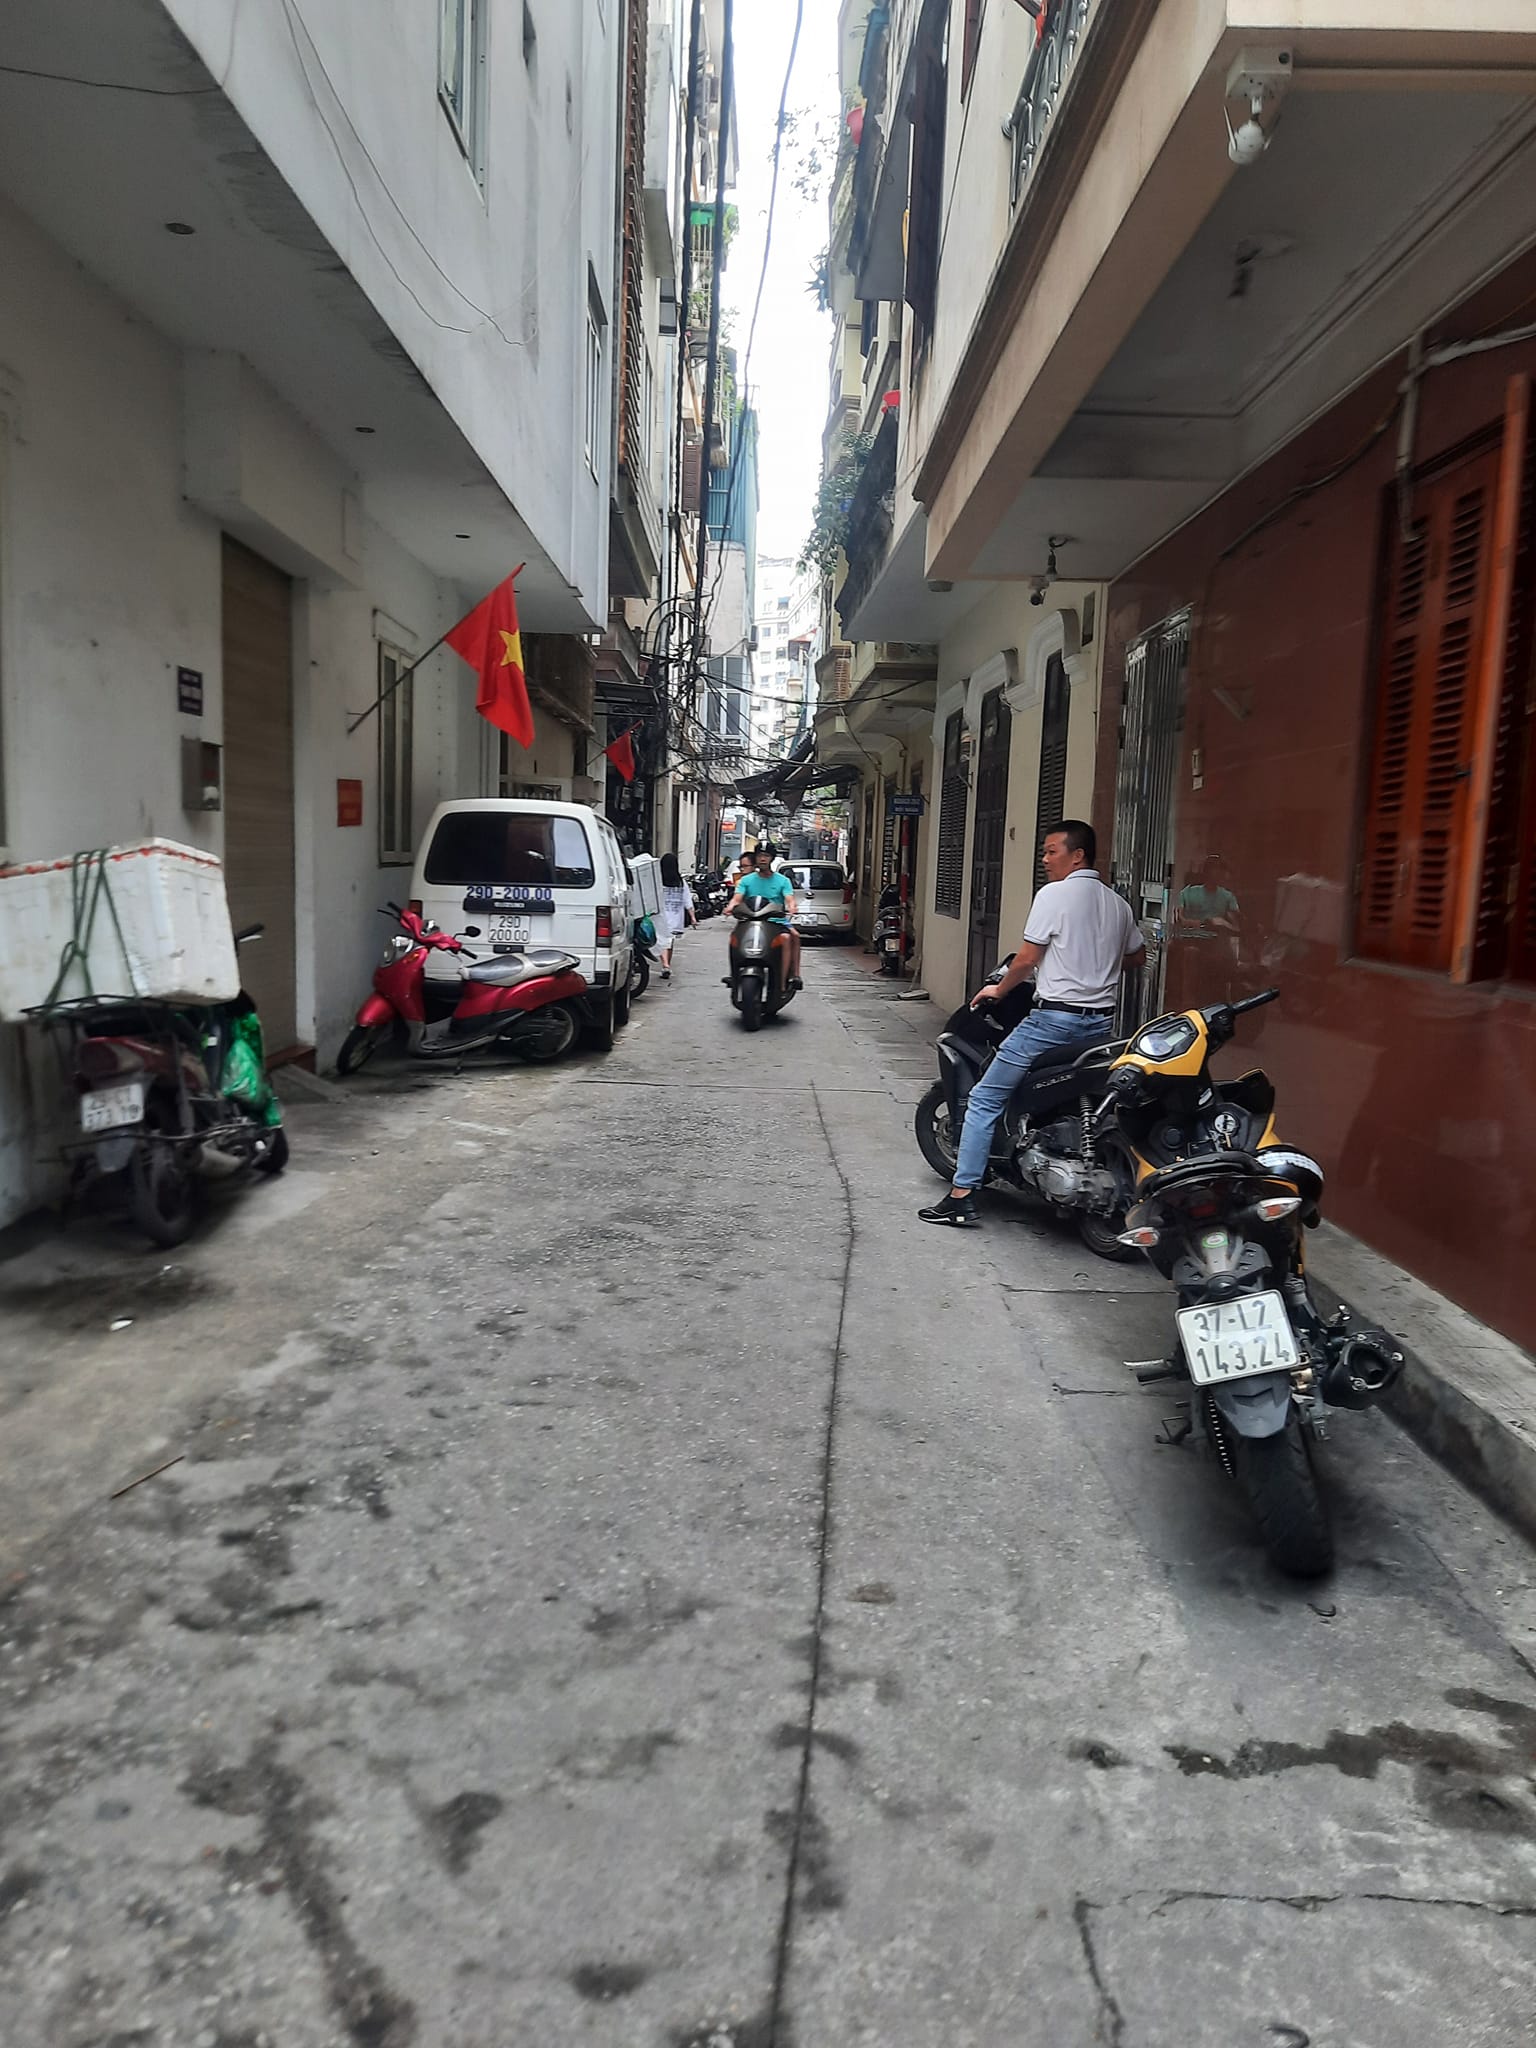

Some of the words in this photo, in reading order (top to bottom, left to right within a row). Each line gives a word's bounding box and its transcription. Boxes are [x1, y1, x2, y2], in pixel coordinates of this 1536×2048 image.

[467, 886, 552, 900] 29D-200.00
[499, 916, 521, 928] 29D
[490, 929, 528, 941] 200.00
[1194, 1300, 1272, 1342] 37-L2
[1196, 1333, 1290, 1378] 143.24
